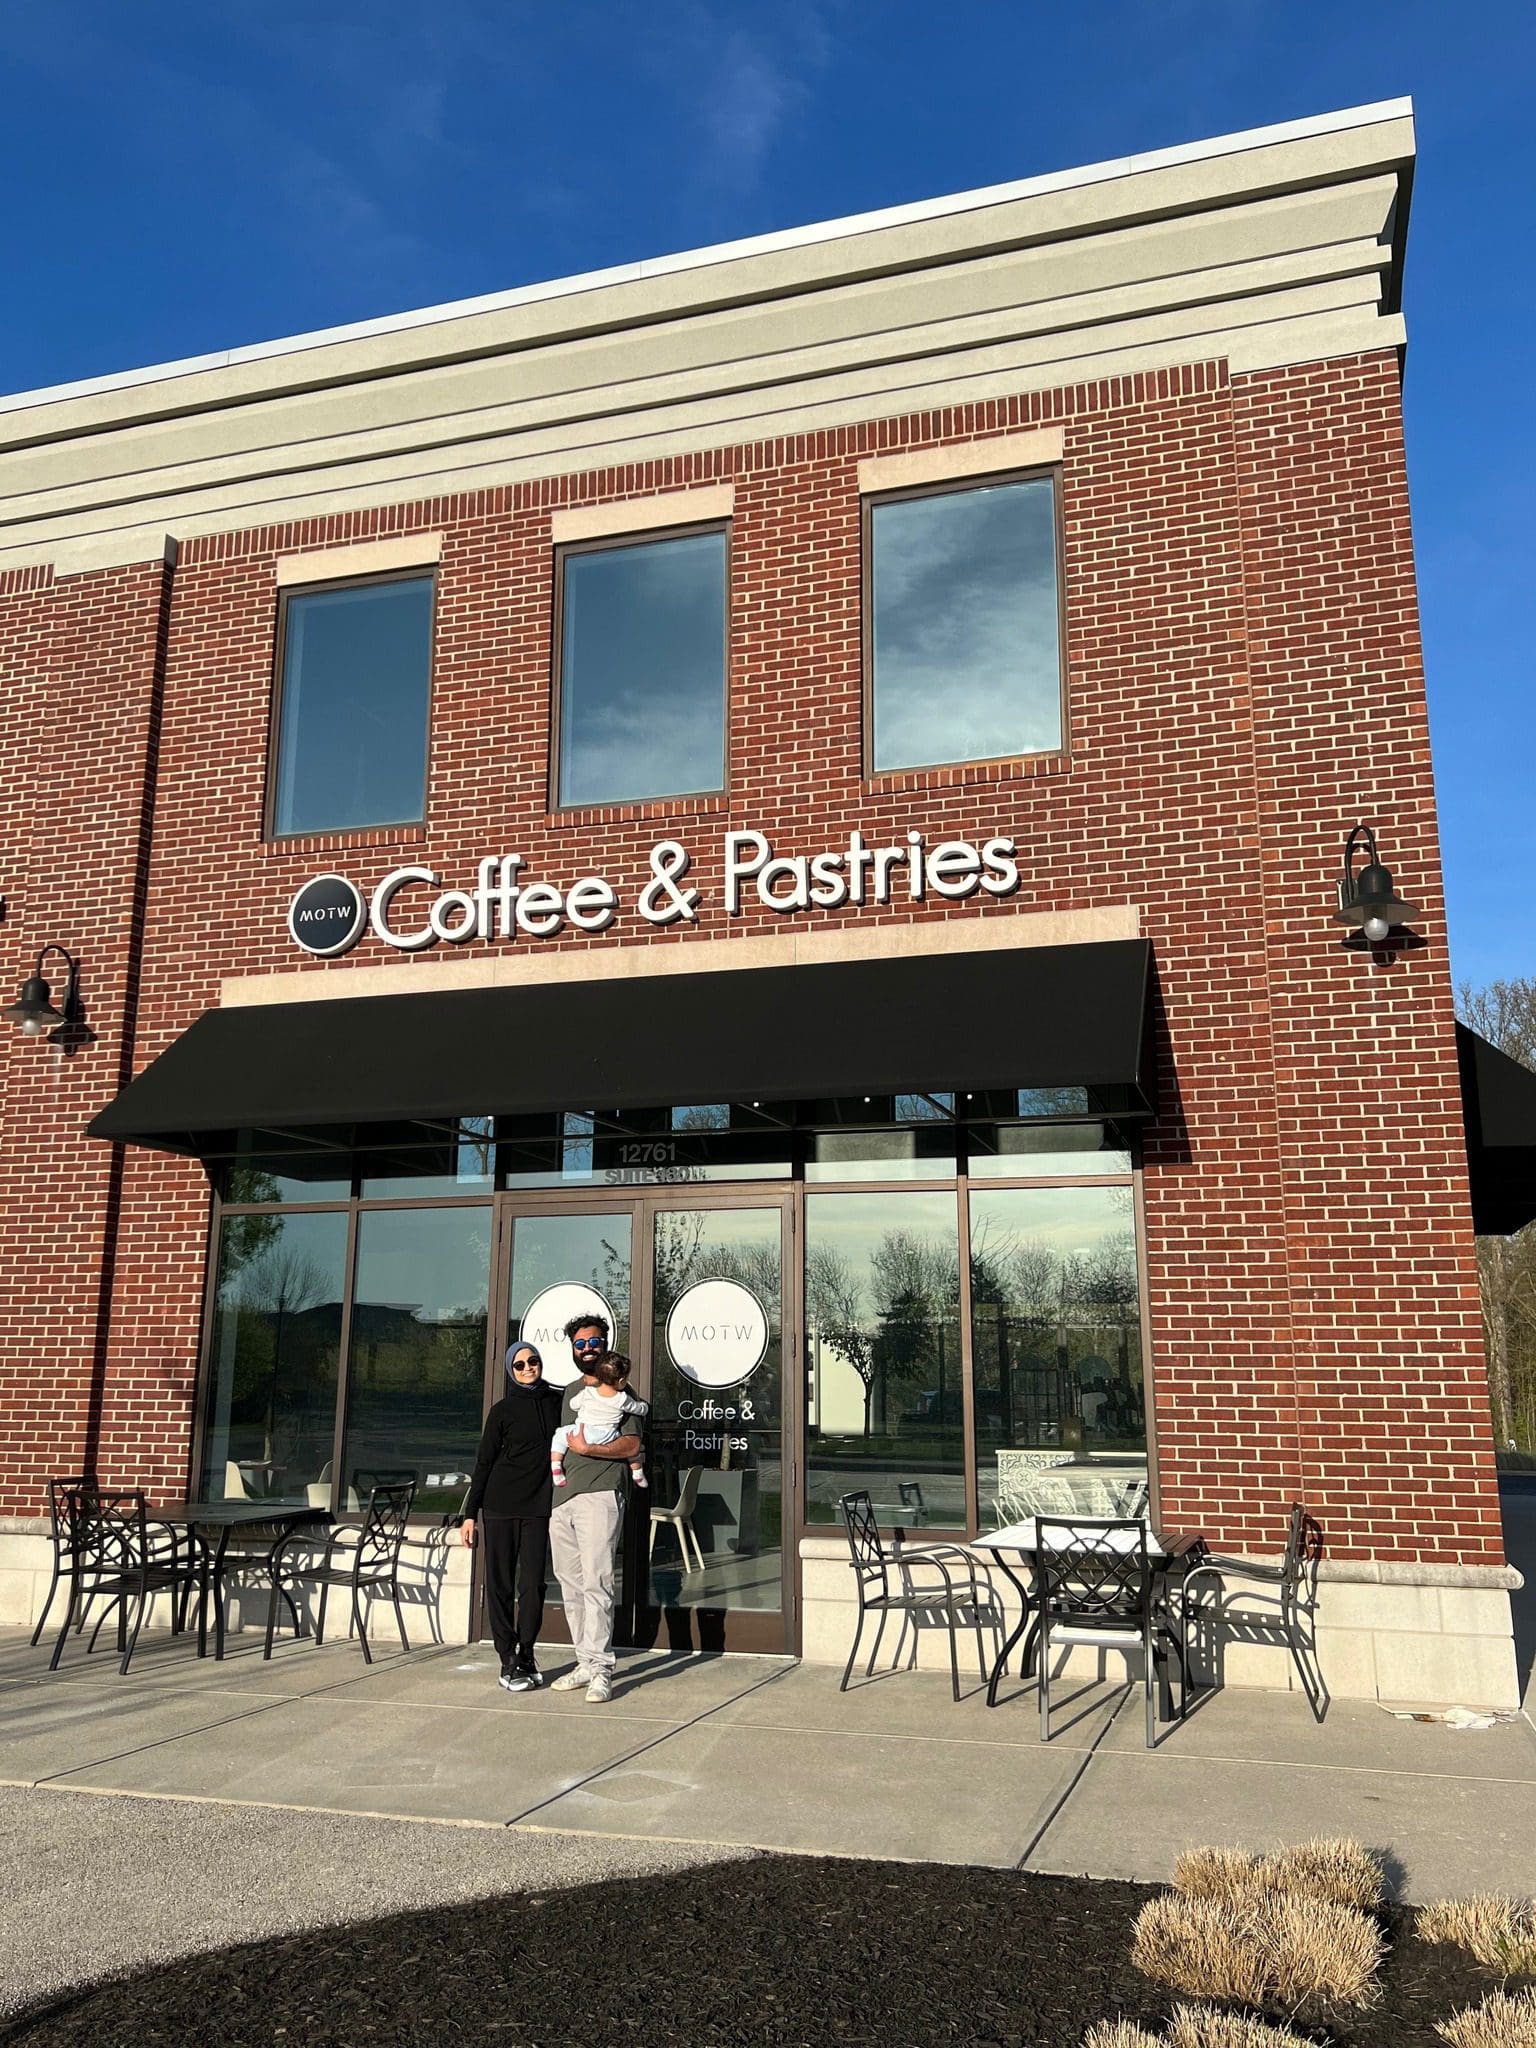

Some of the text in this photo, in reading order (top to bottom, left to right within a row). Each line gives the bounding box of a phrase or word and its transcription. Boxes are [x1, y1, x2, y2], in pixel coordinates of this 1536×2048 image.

[370, 829, 1020, 950] Coffee & Pastries
[299, 905, 351, 922] MOTW
[619, 1142, 677, 1163] 12761
[604, 1167, 655, 1184] SUITE
[680, 1325, 753, 1341] MOTW
[677, 1399, 756, 1421] Coffee &
[685, 1429, 748, 1450] Pastries
